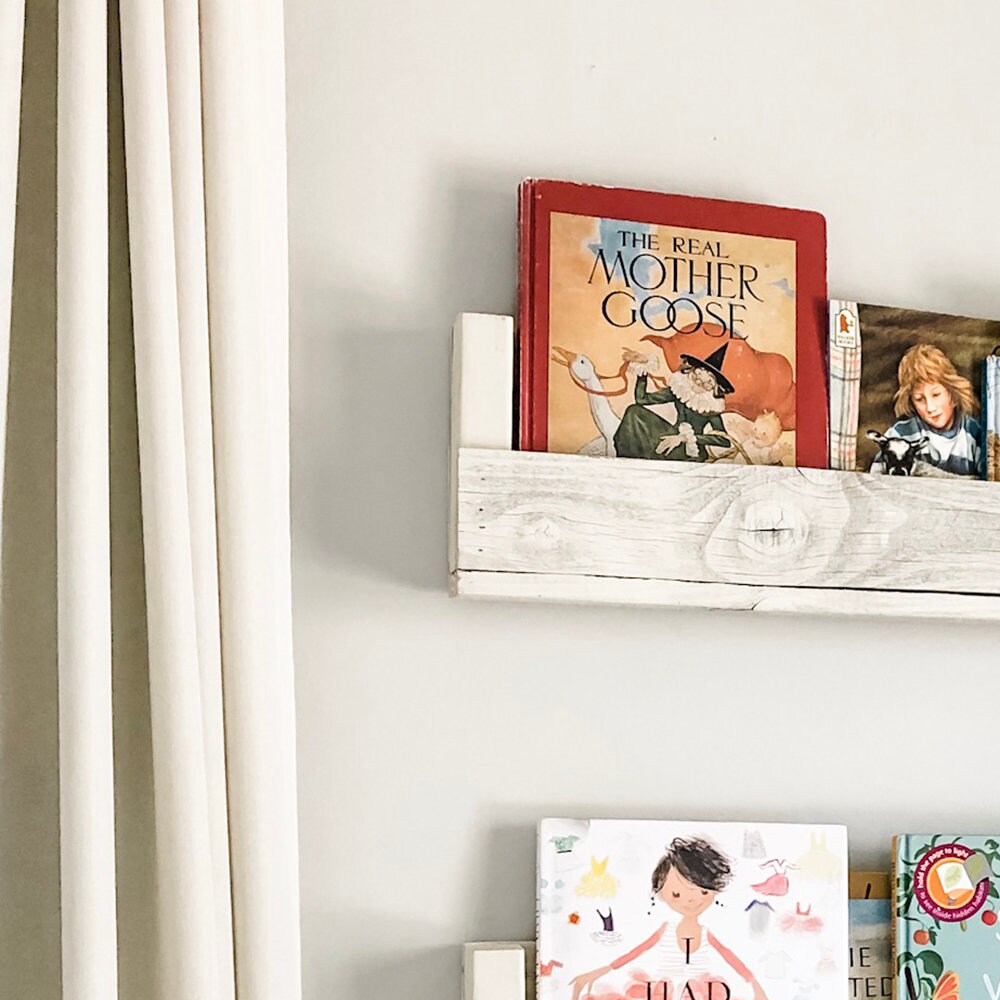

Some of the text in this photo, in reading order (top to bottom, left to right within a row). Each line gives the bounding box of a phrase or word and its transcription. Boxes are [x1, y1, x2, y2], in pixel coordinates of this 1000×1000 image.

[617, 230, 730, 259] THE REAL
[588, 248, 764, 303] MOTHER
[601, 290, 749, 341] GOOSE
[920, 860, 930, 872] the
[928, 849, 945, 862] page
[953, 847, 969, 858] light
[683, 937, 693, 965] I
